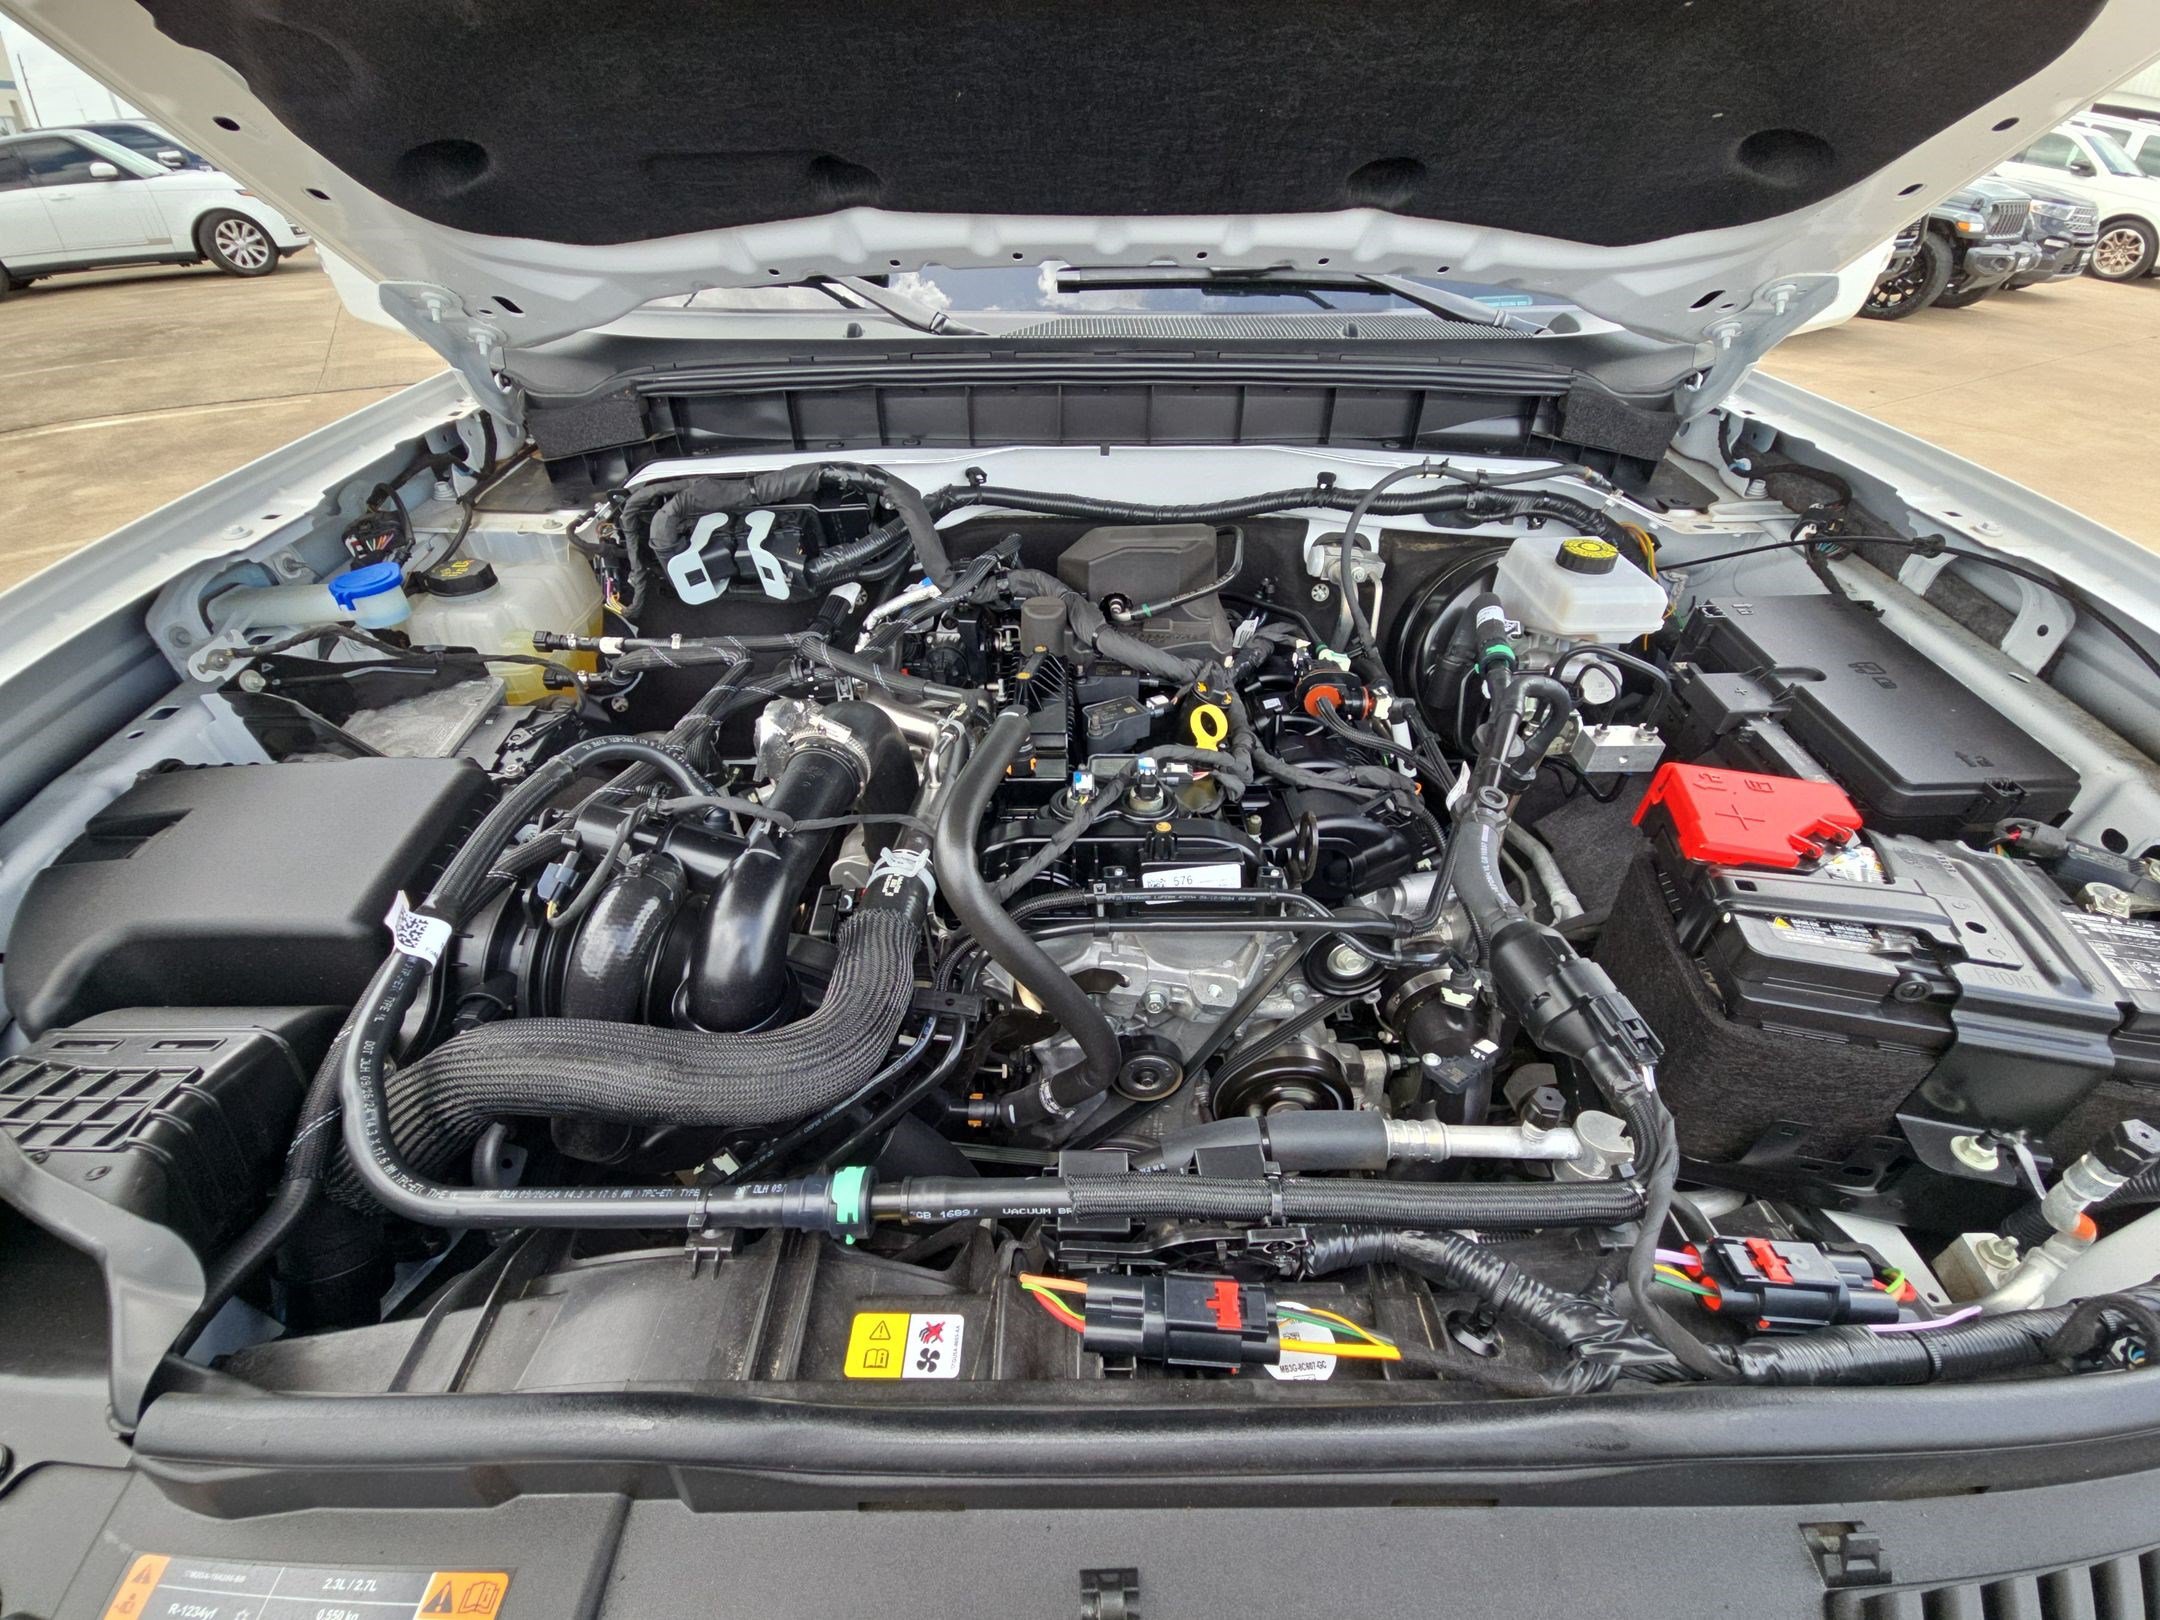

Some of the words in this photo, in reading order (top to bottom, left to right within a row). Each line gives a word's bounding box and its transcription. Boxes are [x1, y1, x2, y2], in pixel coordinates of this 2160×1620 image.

[1173, 875, 1193, 887] 576
[1973, 967, 2040, 990] FRONT
[372, 1147, 391, 1165] 17.6
[563, 1190, 585, 1199] 14.3
[598, 1189, 619, 1199] 17.6
[1002, 1207, 1052, 1215] VACUUM
[321, 1576, 346, 1590] 2.3L
[353, 1578, 377, 1592] 2.7L
